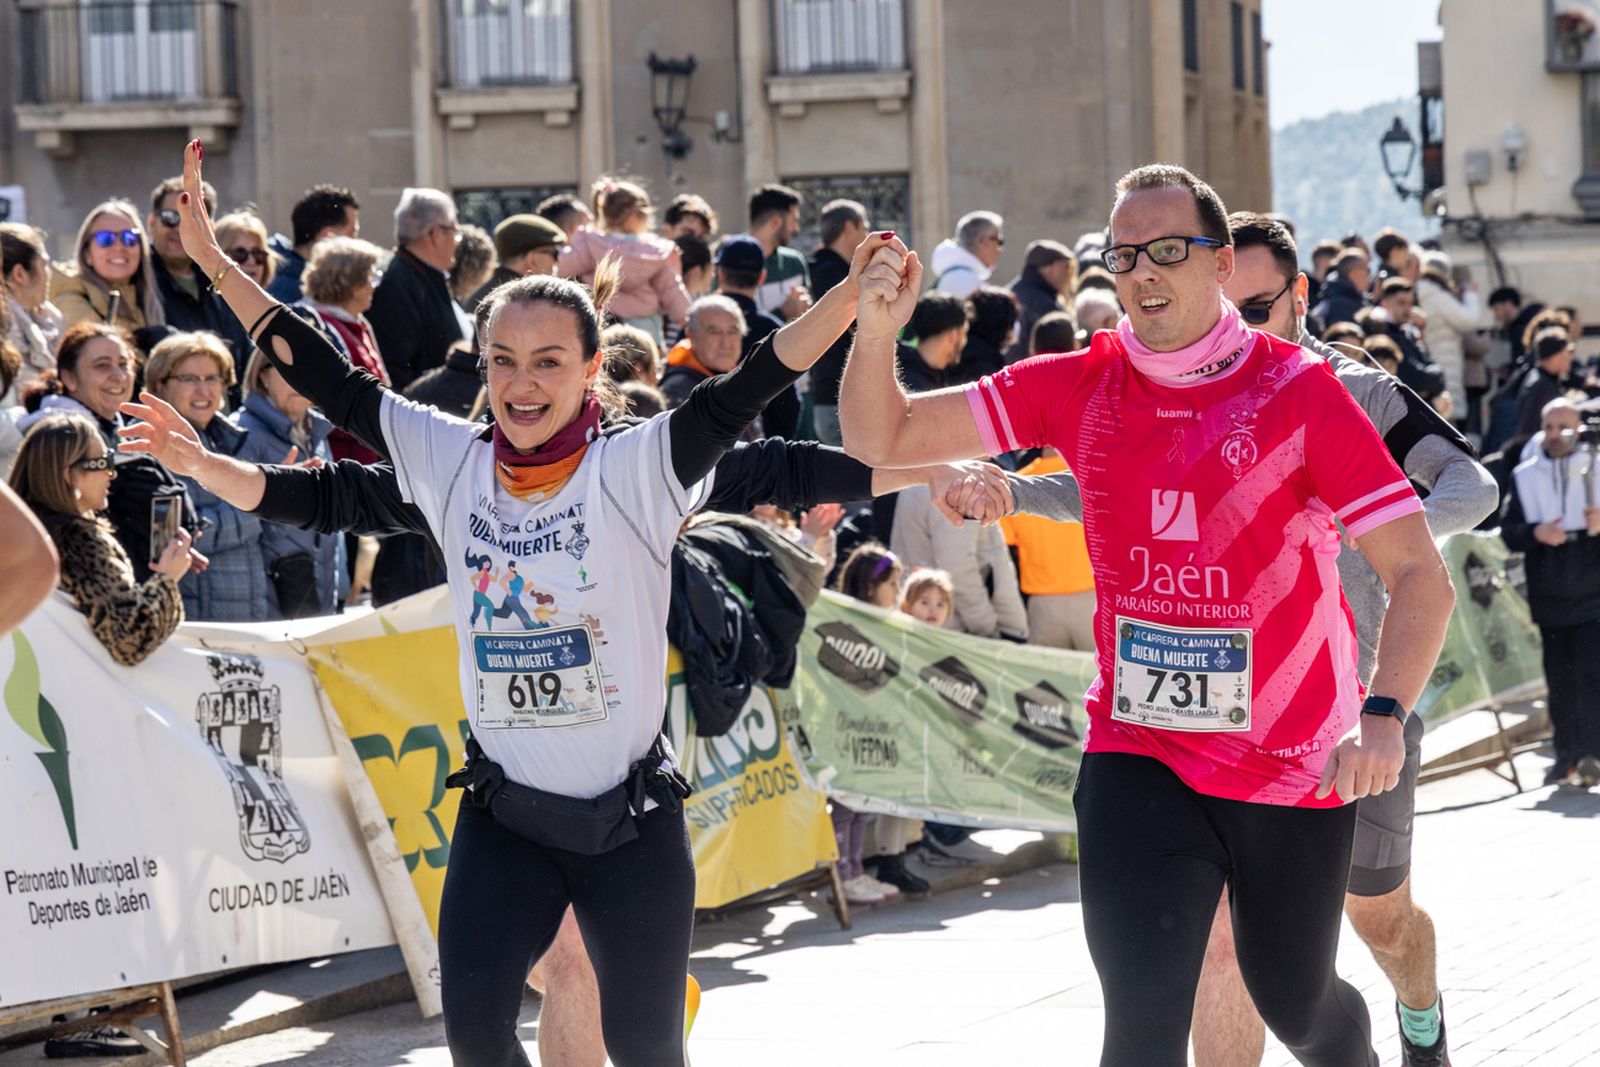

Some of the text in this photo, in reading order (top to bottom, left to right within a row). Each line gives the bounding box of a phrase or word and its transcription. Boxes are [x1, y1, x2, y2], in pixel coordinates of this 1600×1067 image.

[1156, 408, 1192, 418] luanvi
[525, 503, 583, 534] CAMINAT
[499, 530, 562, 557] MUERTE
[1130, 546, 1229, 599] Jaén
[1115, 594, 1251, 619] PARAÍSO INTERIOR
[484, 634, 574, 651] VI CARRERA CAMINATA
[1132, 631, 1232, 649] VI CARRERA CAMINATA
[486, 652, 556, 669] BUENA MUERTE
[1131, 644, 1209, 668] BUENA MUERTE
[508, 672, 562, 709] 619
[1146, 668, 1208, 709] 731
[5, 867, 70, 895] Patronato
[71, 856, 140, 888] Municipal
[208, 868, 351, 913] CIUDAD DE JAÉN
[28, 887, 151, 930] Deportes de Jaén
